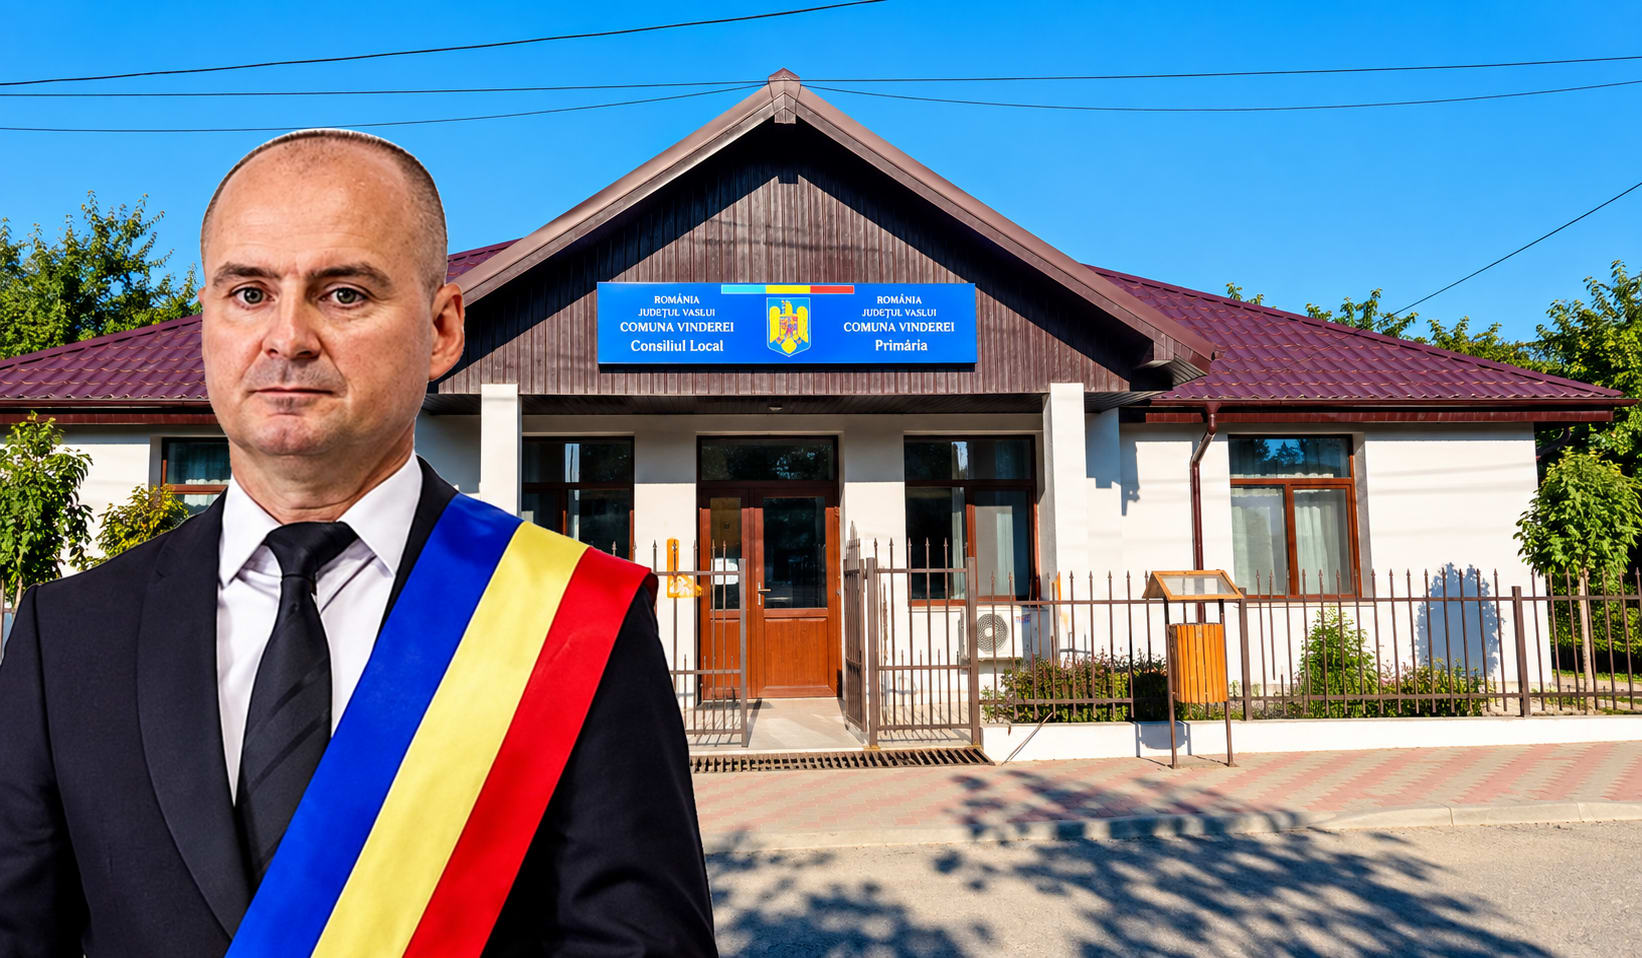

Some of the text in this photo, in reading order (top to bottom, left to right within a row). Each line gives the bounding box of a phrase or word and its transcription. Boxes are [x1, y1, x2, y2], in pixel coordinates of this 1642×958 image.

[682, 308, 716, 317] VASLUI
[904, 308, 937, 317] VASLUI
[619, 321, 735, 333] COMUNA VINDEREI
[843, 321, 955, 333] COMUNA VINDEREI
[630, 339, 725, 352] Consiliul Local
